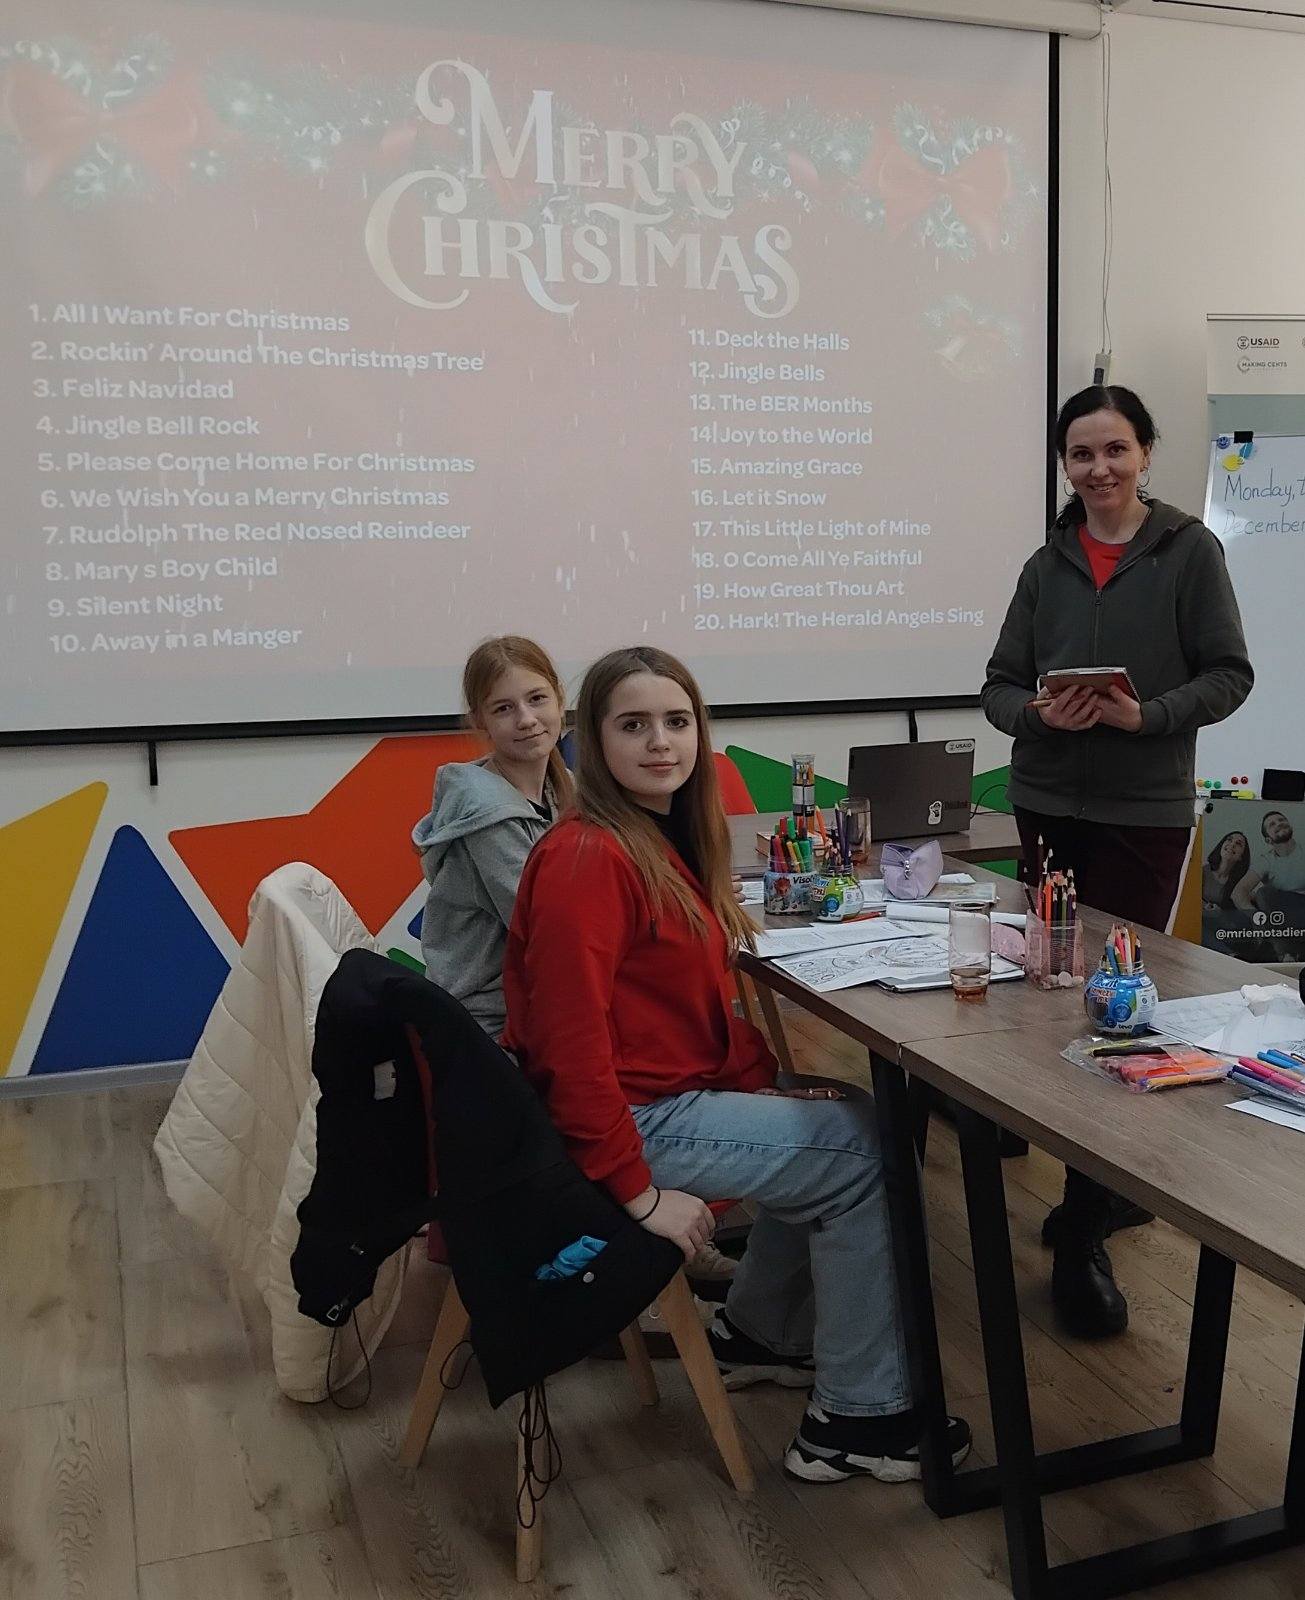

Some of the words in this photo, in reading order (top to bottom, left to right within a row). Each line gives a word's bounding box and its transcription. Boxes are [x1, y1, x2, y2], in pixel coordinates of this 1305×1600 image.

[415, 59, 748, 219] MERRY
[365, 170, 800, 318] CHRISTMAS
[29, 304, 47, 322] 1.
[53, 304, 85, 323] All
[92, 305, 98, 324] I
[103, 305, 176, 325] Want
[179, 307, 221, 326] For
[226, 308, 350, 331] Christmas
[688, 329, 710, 346] 11.
[715, 330, 764, 347] Deck
[767, 332, 799, 349] the
[804, 333, 850, 350] Halls
[1250, 337, 1280, 346] USAID
[30, 341, 54, 360] 2.
[160, 343, 252, 363] Around
[260, 345, 303, 365] The
[308, 348, 429, 369] Christmas
[432, 352, 484, 371] Tree
[689, 361, 715, 379] 12.
[719, 362, 775, 384] Jingle
[780, 364, 825, 381] Bells
[33, 379, 56, 397] 3.
[63, 378, 122, 398] Feliz
[129, 379, 234, 399] Navidad
[690, 394, 716, 411] 13.
[719, 394, 756, 411] The
[761, 396, 799, 412] BER
[803, 397, 873, 414] Months
[36, 416, 60, 434] 4.
[65, 416, 141, 440] Jingle
[148, 416, 193, 434] Bell
[200, 416, 259, 435] Rock
[720, 427, 754, 447] Joy
[758, 428, 778, 443] to
[782, 426, 813, 443] the
[817, 428, 873, 444] World
[37, 453, 61, 471] 5.
[67, 453, 151, 471] Please
[157, 453, 230, 471] Come
[236, 453, 307, 471] Home
[313, 453, 353, 470] For
[357, 453, 475, 472] Christmas
[691, 458, 717, 474] 15.
[720, 458, 804, 479] Amazing
[807, 459, 863, 475] Grace
[40, 489, 64, 508] 6.
[70, 489, 111, 508] We
[116, 488, 179, 507] Wish
[183, 488, 229, 506] You
[235, 492, 249, 506] a
[255, 488, 326, 509] Merry
[330, 487, 449, 506] Christmas
[691, 490, 718, 506] 16.
[722, 490, 753, 506] Let
[758, 489, 772, 505] it
[775, 490, 826, 505] Snow
[1225, 468, 1294, 507] Monday,
[42, 527, 64, 544] 7.
[70, 525, 178, 546] Rudolph
[182, 523, 229, 542] The
[234, 522, 281, 541] Red
[287, 521, 362, 540] Nosed
[368, 521, 471, 539] Reindeer
[692, 521, 717, 537] 17.
[720, 520, 760, 537] This
[765, 520, 814, 537] Little
[818, 519, 864, 540] Light
[867, 520, 888, 536] of
[888, 520, 931, 536] Mine
[46, 562, 69, 580] 8.
[162, 560, 210, 581] Boy
[215, 557, 277, 577] Child
[694, 552, 719, 568] 18.
[723, 552, 739, 567] O
[743, 551, 798, 567] Come
[801, 550, 825, 566] All
[827, 550, 850, 566] Ye
[853, 549, 922, 566] Faithful
[694, 583, 720, 599] 19.
[724, 583, 767, 598] How
[770, 582, 823, 598] Great
[825, 580, 872, 597] Thou
[875, 580, 905, 595] Art
[48, 599, 71, 617] 9.
[77, 597, 150, 616] Silent
[156, 594, 223, 617] Night
[694, 614, 725, 630] 20.
[728, 612, 779, 629] Hark!
[783, 611, 818, 628] The
[822, 610, 882, 627] Herald
[885, 608, 944, 628] Angels
[947, 607, 984, 627] Sing
[50, 634, 85, 653] 10.
[91, 633, 159, 653] Away
[165, 630, 187, 649] in
[193, 633, 207, 648] a
[213, 628, 302, 649] Manger
